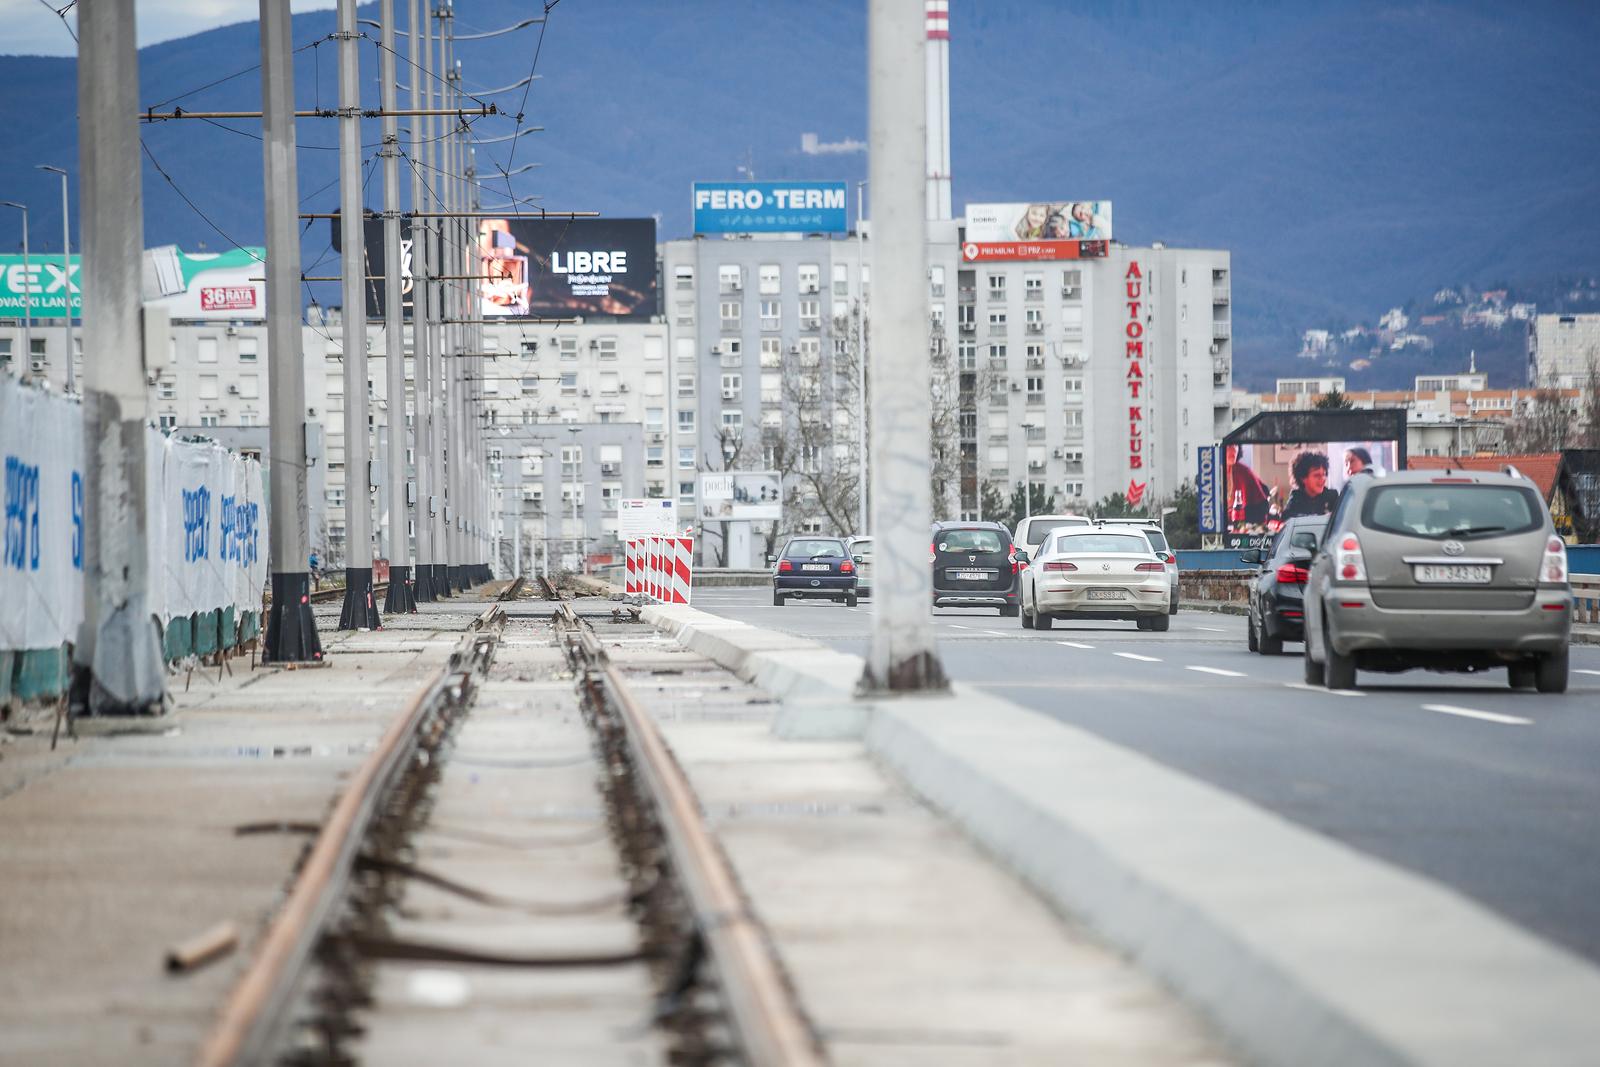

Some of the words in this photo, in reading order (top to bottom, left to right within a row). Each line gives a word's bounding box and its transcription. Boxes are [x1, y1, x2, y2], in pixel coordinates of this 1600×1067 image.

[696, 189, 763, 210] FERO
[773, 189, 845, 209] TERM
[552, 251, 627, 273] LIBRE
[42, 297, 81, 308] LANC
[204, 289, 225, 305] 36
[1126, 261, 1143, 398] AUTOMAT
[1129, 407, 1142, 469] KLUB
[1201, 449, 1214, 530] SENATOR
